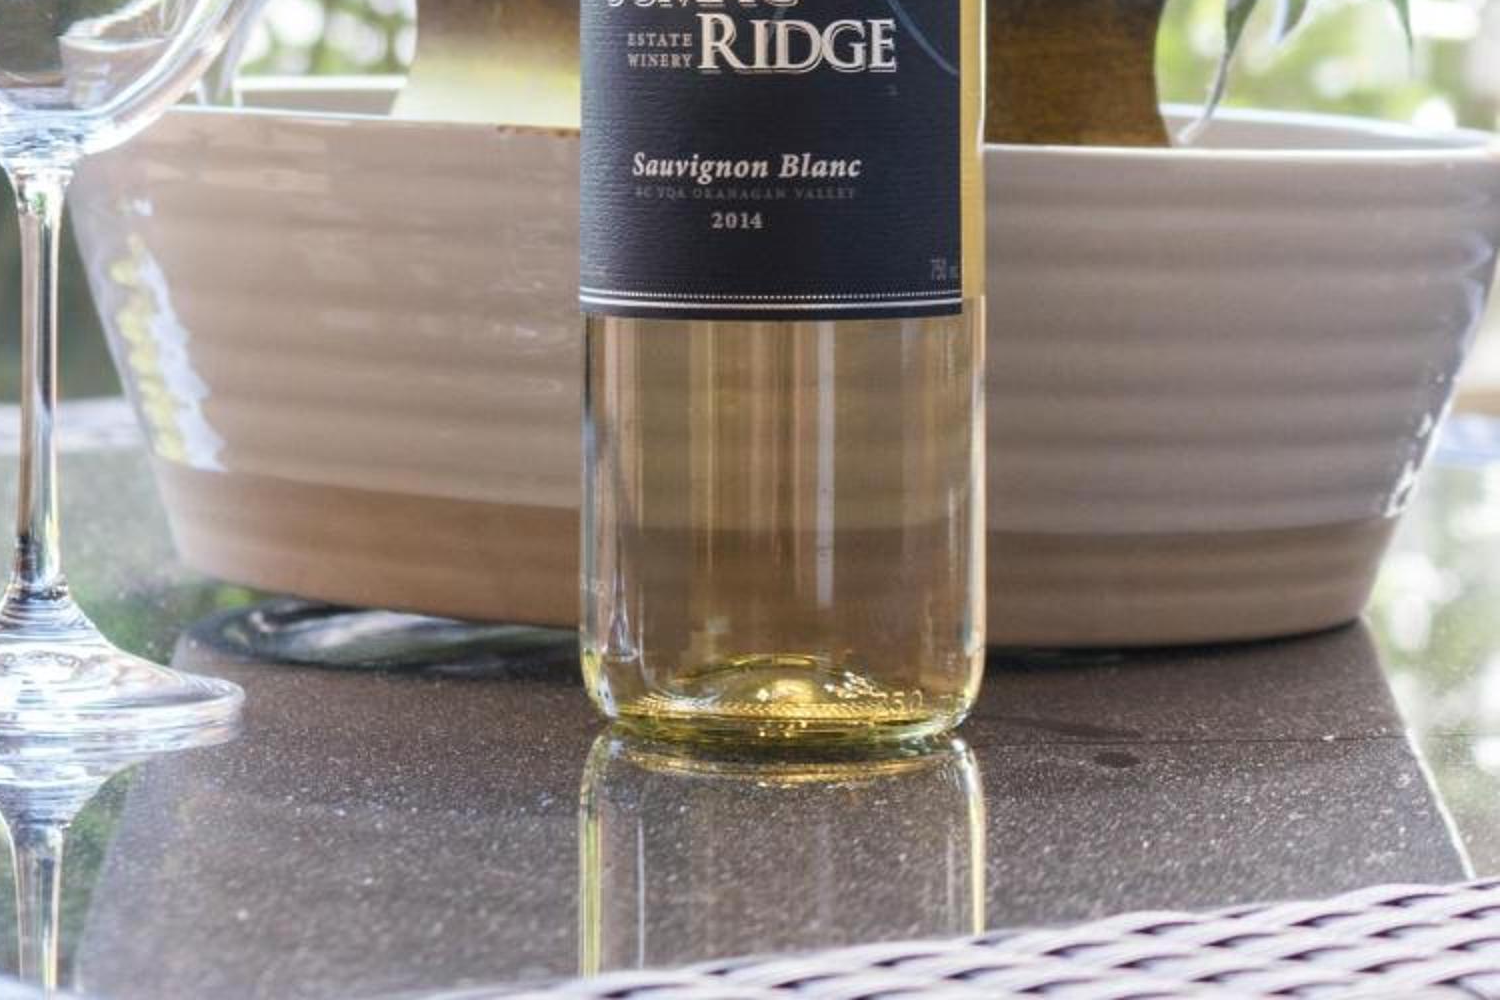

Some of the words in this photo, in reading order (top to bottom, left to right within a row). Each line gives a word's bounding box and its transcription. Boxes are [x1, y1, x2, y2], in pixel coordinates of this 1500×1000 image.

[627, 33, 693, 47] ESTATE
[696, 12, 897, 74] RIDGE
[627, 53, 692, 68] WINERY
[632, 152, 769, 184] Sauvignon
[779, 153, 862, 178] Blanc
[693, 186, 787, 200] OKANAGAN
[795, 186, 856, 199] VALLEY
[711, 213, 762, 230] 2014
